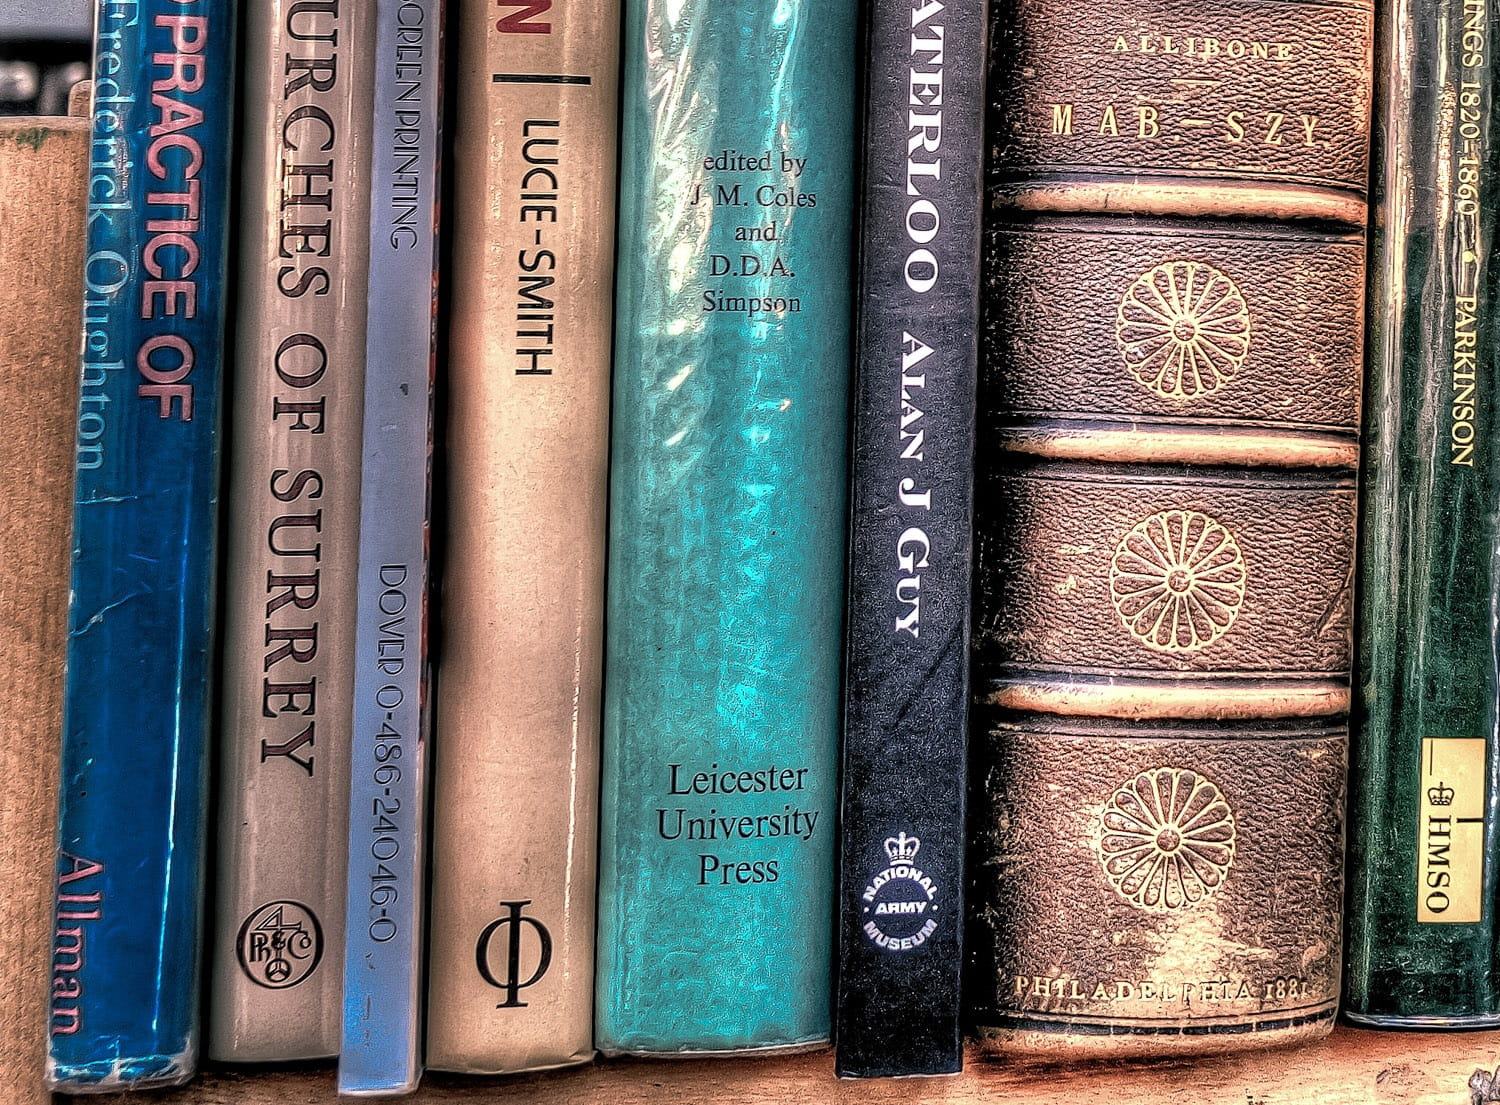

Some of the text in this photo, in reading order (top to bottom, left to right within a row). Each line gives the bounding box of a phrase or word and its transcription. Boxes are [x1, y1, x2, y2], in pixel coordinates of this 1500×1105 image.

[1111, 34, 1294, 62] ALLIBONE
[141, 14, 208, 320] PRACTICE
[390, 111, 424, 251] PRINTING
[703, 149, 807, 178] edited by
[756, 184, 817, 208] Coles
[515, 118, 560, 376] LUCIE-SMITH
[709, 254, 796, 278] D.D.A.
[735, 220, 777, 242] and
[702, 290, 803, 318] Simpson
[76, 249, 130, 471] Oughton
[136, 334, 196, 422] OF
[273, 333, 328, 435] OF
[900, 331, 935, 462] ALAN
[1450, 295, 1478, 467] PARKINSON
[898, 477, 931, 511] J
[261, 468, 324, 777] SURREY
[374, 563, 408, 679] DOVER
[895, 527, 931, 639] GUY
[367, 683, 405, 943] 0-486-24046-0
[656, 804, 819, 841] University
[668, 762, 809, 796] Leicester
[696, 853, 779, 886] Press
[863, 866, 939, 902] NATIONAL
[1425, 814, 1452, 914] HMSO
[50, 847, 106, 1037] Allman
[863, 918, 939, 951] MUSEUM
[875, 901, 927, 916] ARMY
